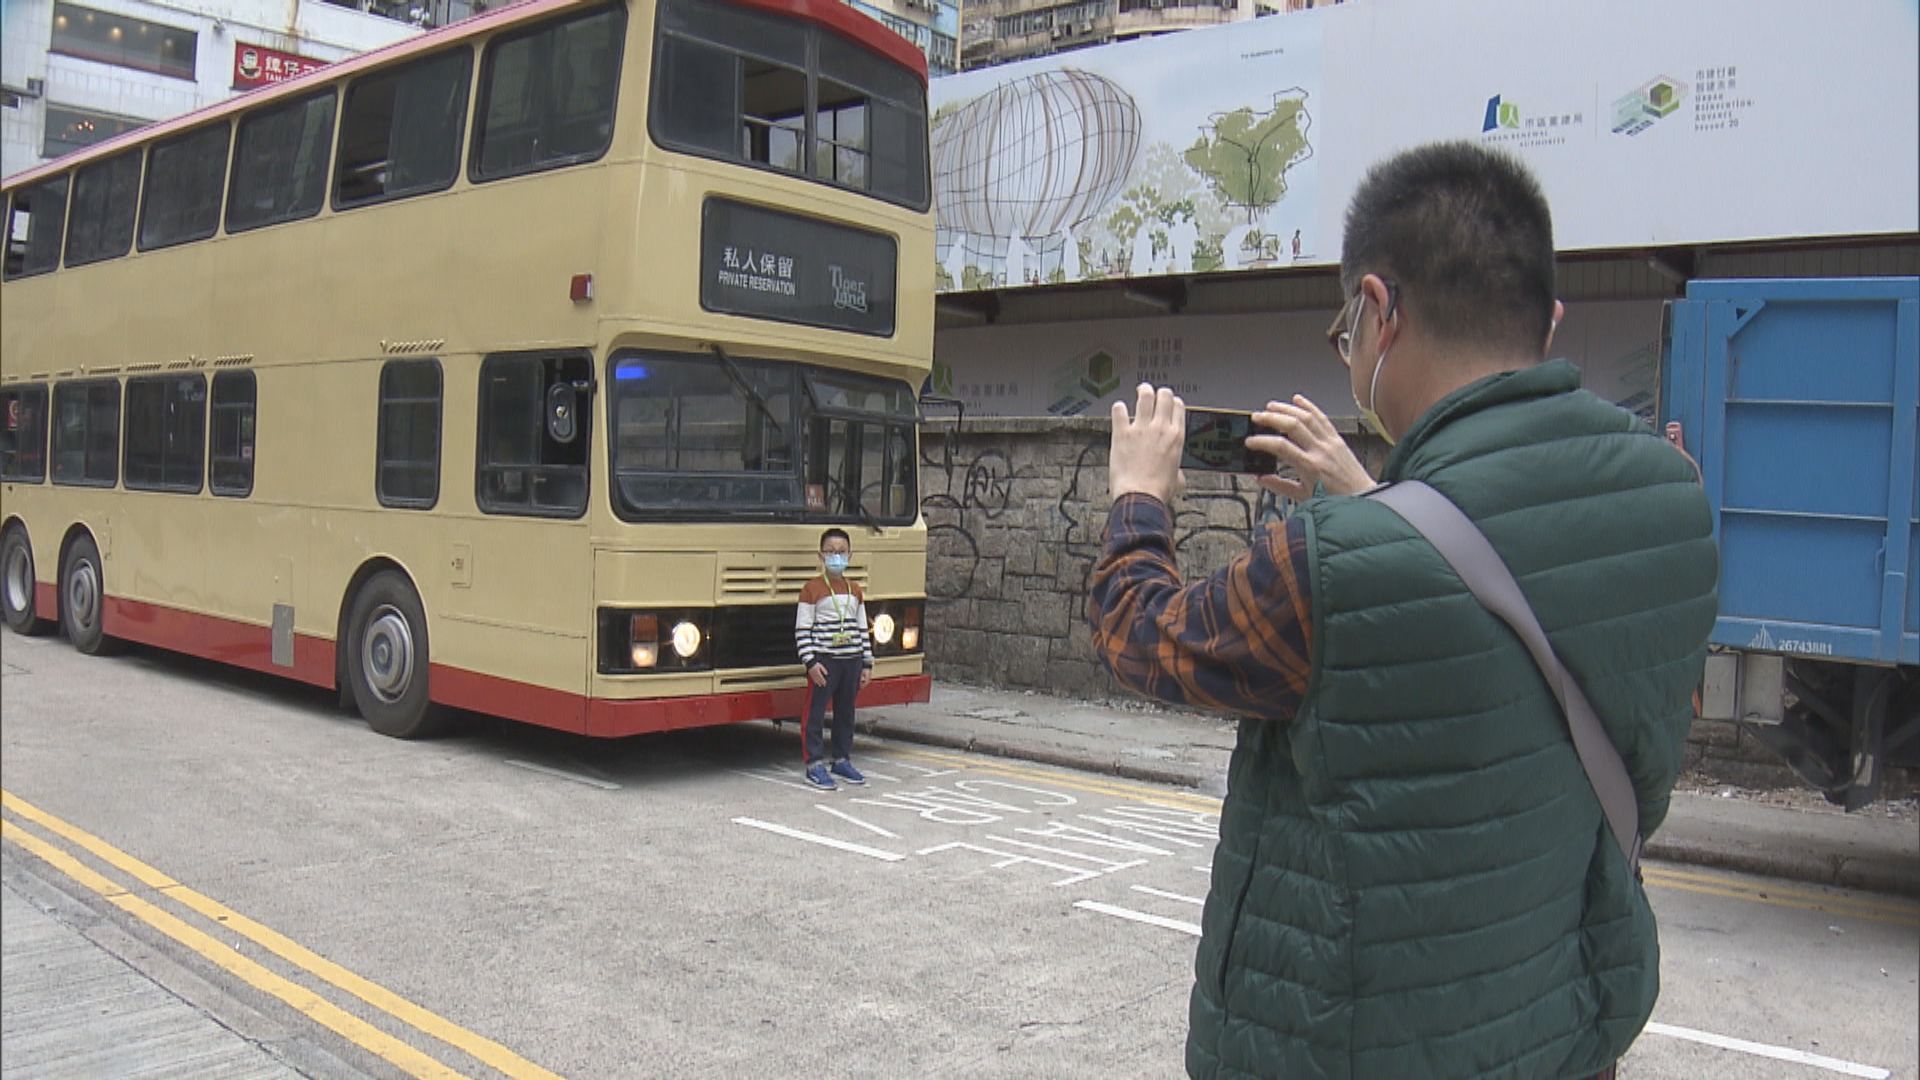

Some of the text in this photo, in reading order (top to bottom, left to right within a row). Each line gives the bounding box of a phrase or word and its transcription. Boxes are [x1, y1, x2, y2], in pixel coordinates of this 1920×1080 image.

[723, 247, 794, 279] 私人保留
[718, 269, 796, 296] PRIVATE RESERVATION
